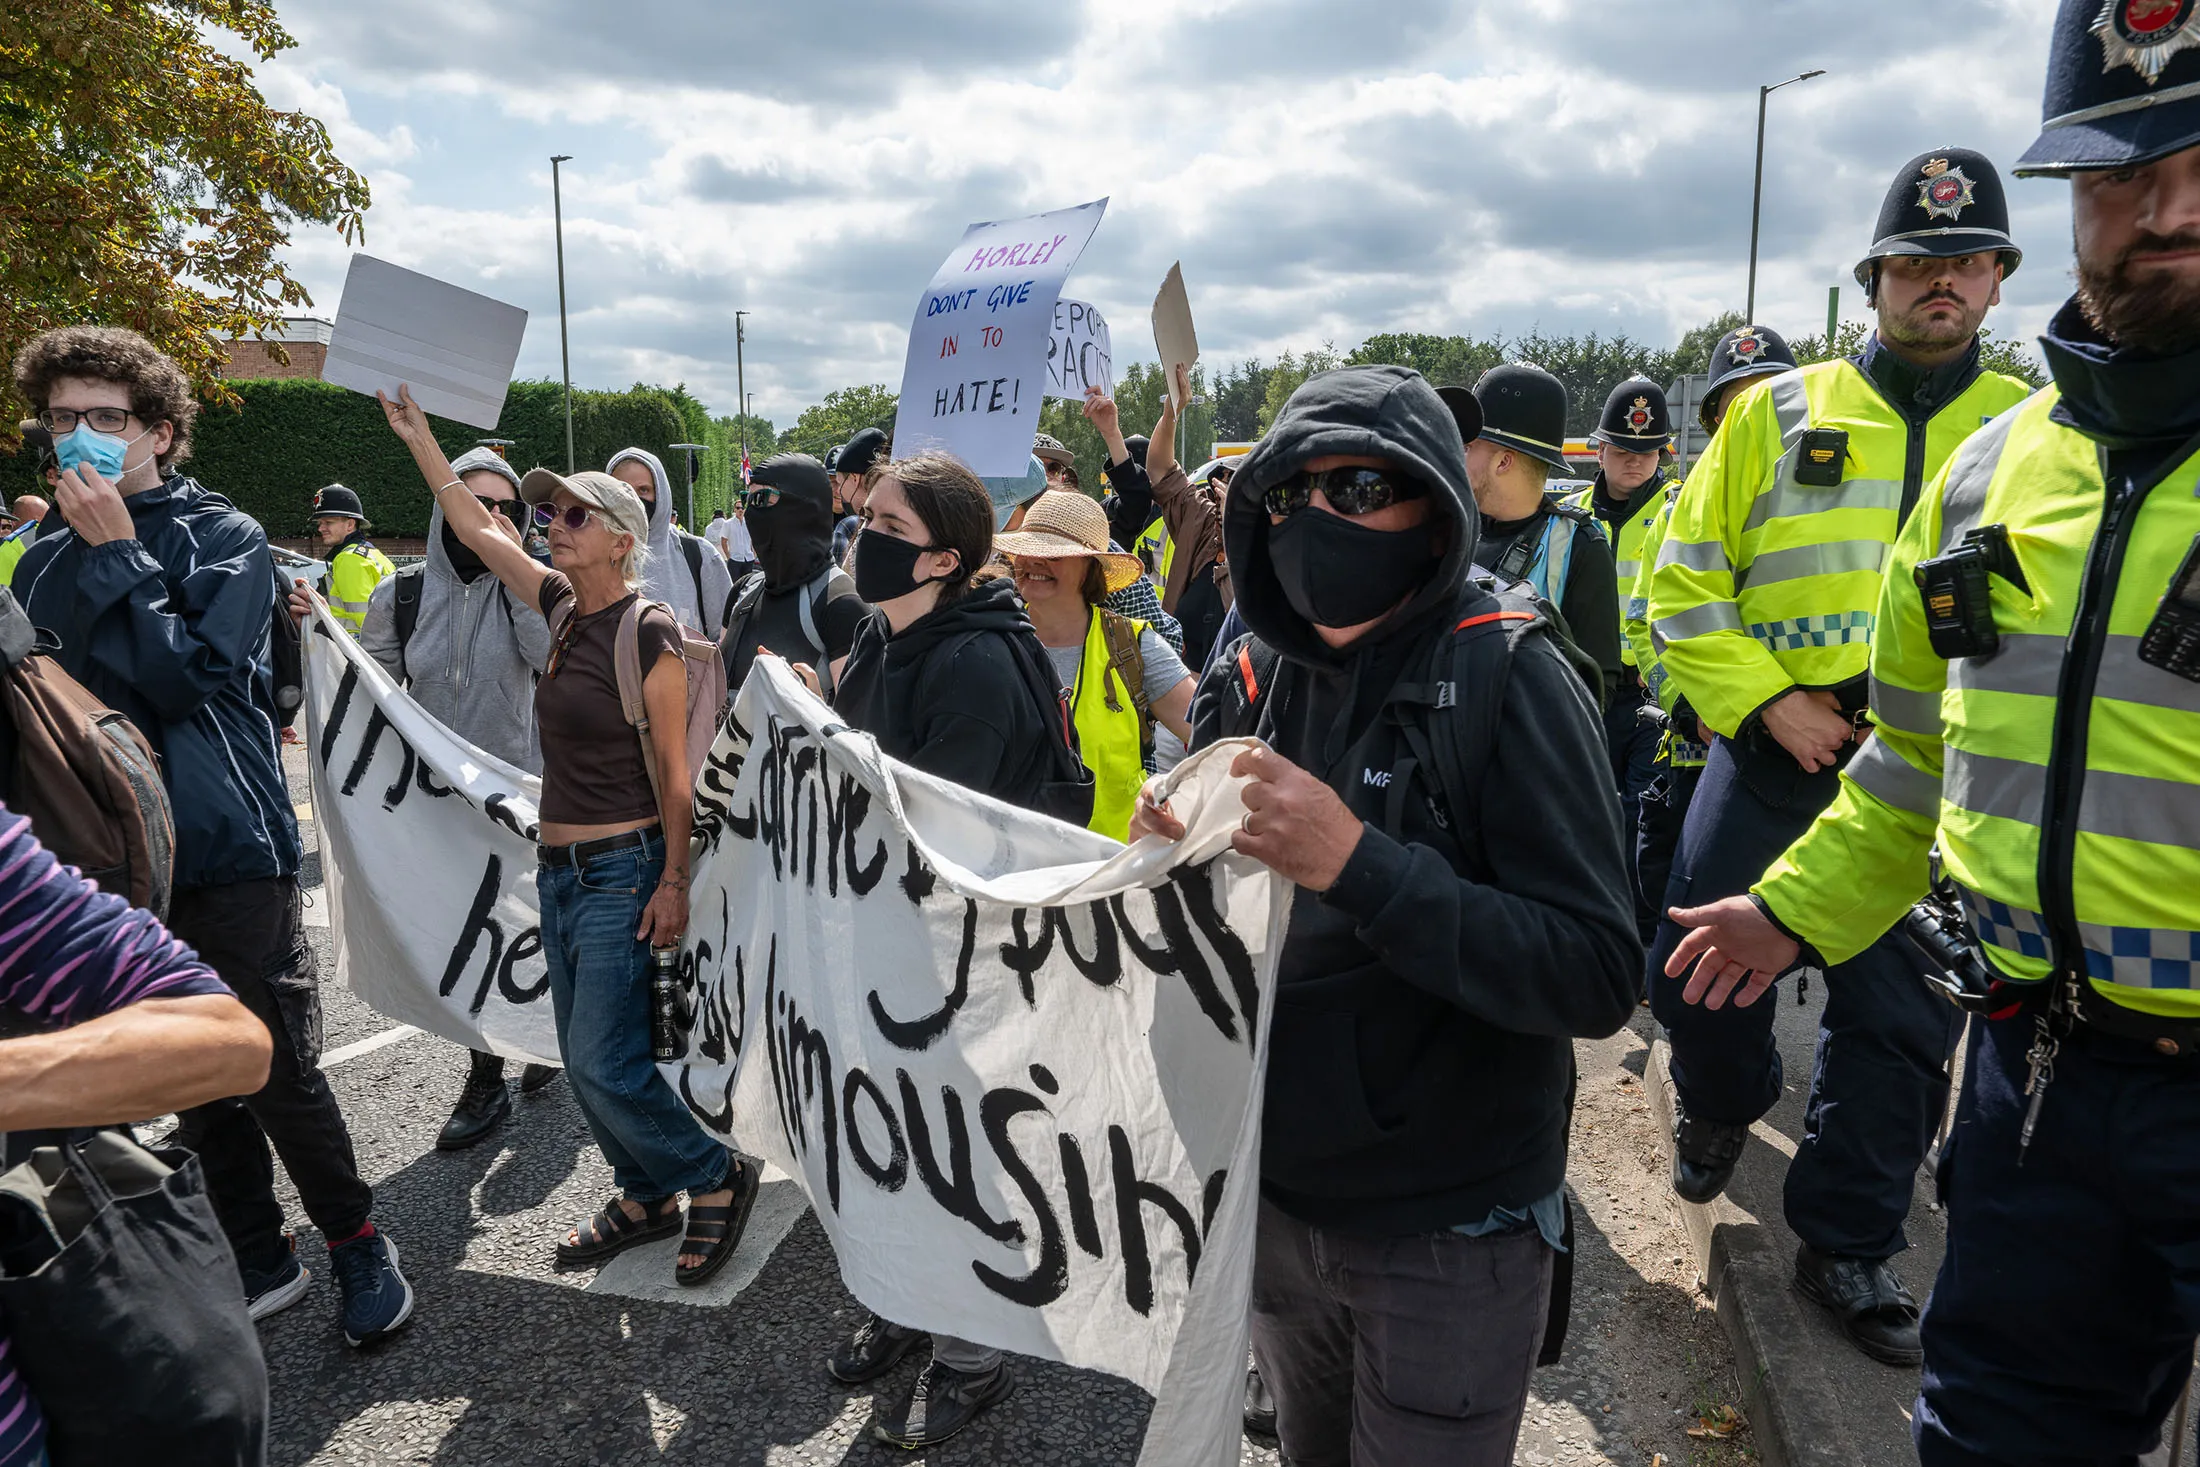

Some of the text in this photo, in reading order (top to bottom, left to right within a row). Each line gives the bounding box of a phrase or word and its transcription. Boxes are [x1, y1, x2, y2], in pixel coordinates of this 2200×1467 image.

[964, 234, 1067, 272] HORLEY
[927, 280, 1036, 317] DON'T GIVE
[1053, 301, 1110, 344] EPORT
[940, 326, 1004, 359] IN TO
[933, 377, 1021, 417] HATE!
